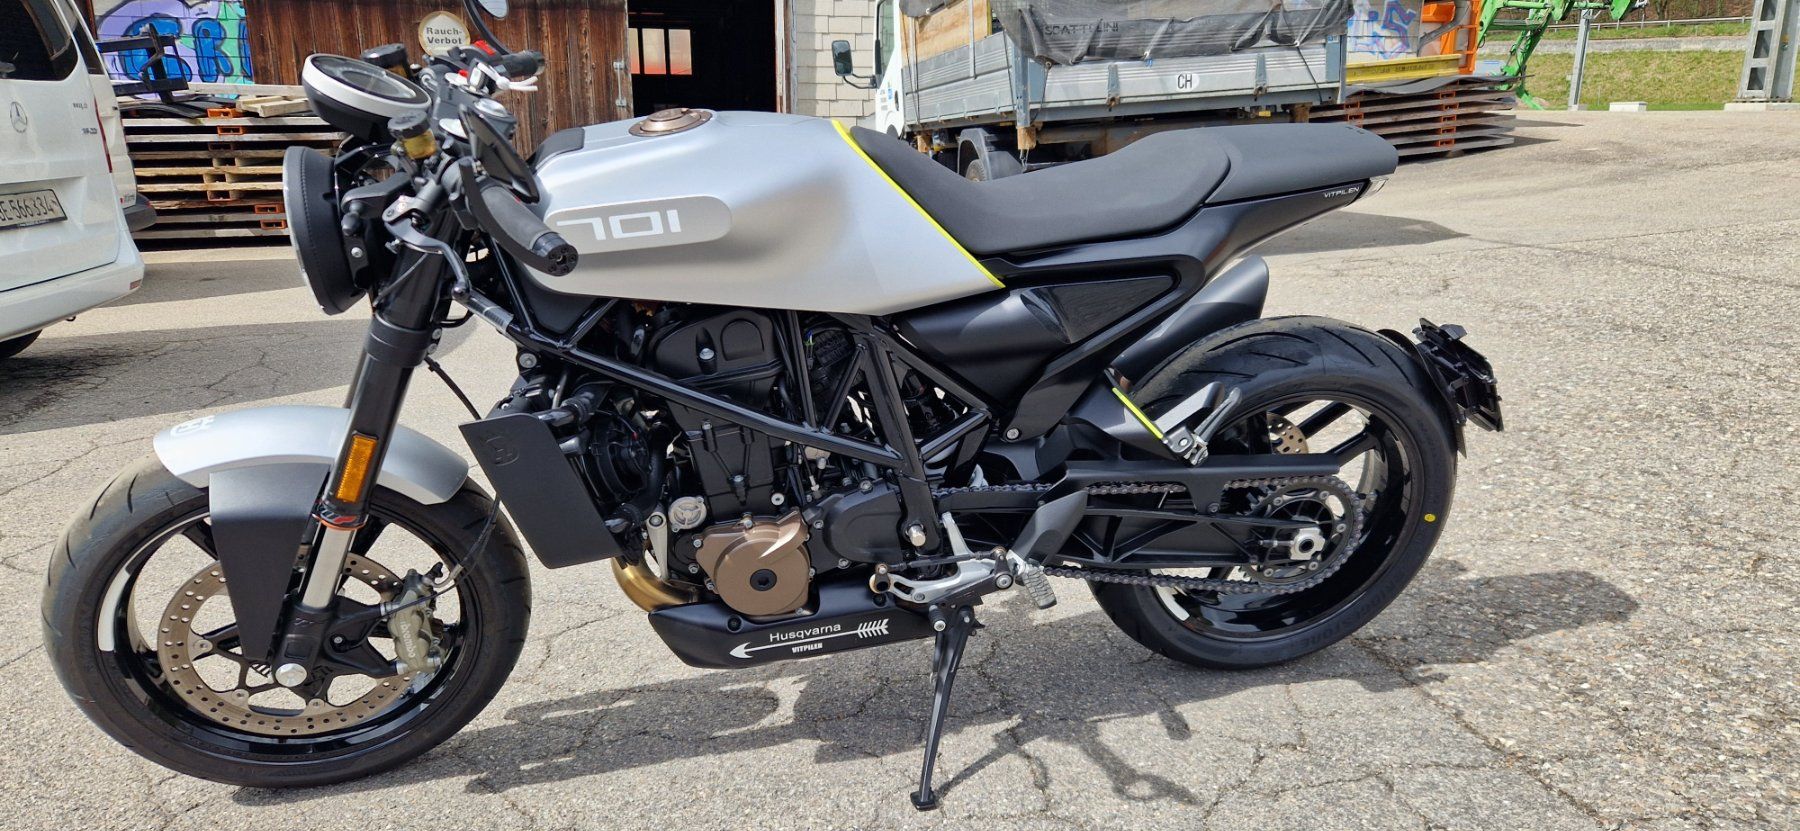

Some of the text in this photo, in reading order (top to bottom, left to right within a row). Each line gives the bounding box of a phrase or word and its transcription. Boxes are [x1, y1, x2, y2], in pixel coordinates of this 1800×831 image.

[426, 27, 463, 35] Rauch-
[1177, 73, 1193, 89] CH
[1323, 186, 1360, 198] VITPILEN
[556, 209, 682, 241] 701
[770, 624, 841, 642] Husqvarna
